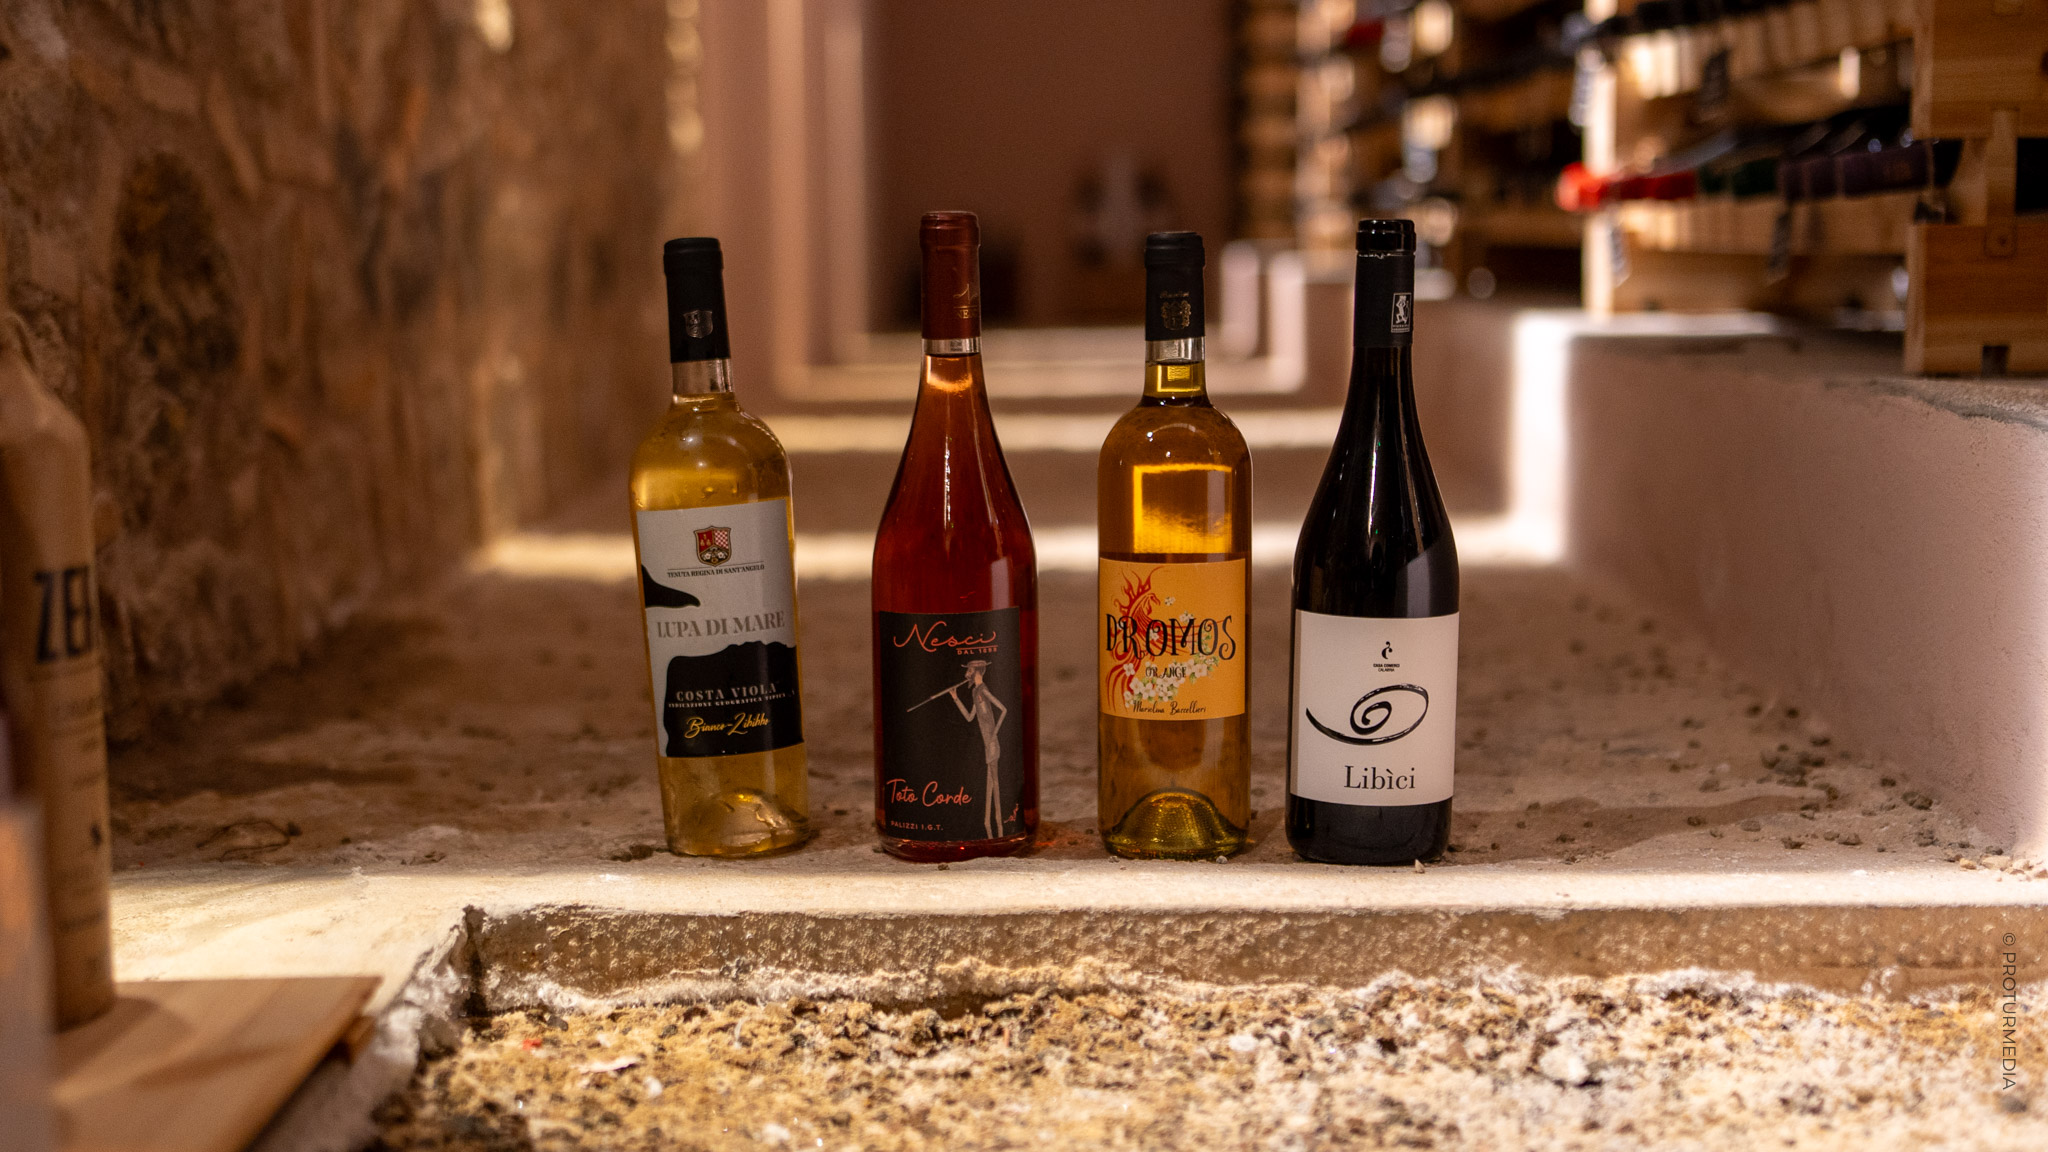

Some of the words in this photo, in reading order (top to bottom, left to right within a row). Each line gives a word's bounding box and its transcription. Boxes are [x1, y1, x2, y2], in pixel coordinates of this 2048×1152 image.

[667, 570, 690, 578] TENUTA
[691, 568, 715, 577] REGINA
[724, 564, 765, 575] SANT'ANGELO
[656, 620, 701, 639] LUPA
[705, 618, 729, 636] DI
[733, 611, 785, 634] MARE
[893, 620, 997, 652] Nesci
[1106, 613, 1237, 661] DROMOS
[1145, 666, 1187, 681] ORANGE
[676, 689, 725, 702] COSTA
[731, 682, 777, 698] VIOLA
[715, 697, 762, 706] GEOGRAFICA
[1343, 764, 1416, 790] Libìci
[886, 778, 919, 804] Toto
[922, 780, 973, 807] Corde
[890, 820, 919, 830] PALIZZI
[921, 823, 944, 831] I.G.T.
